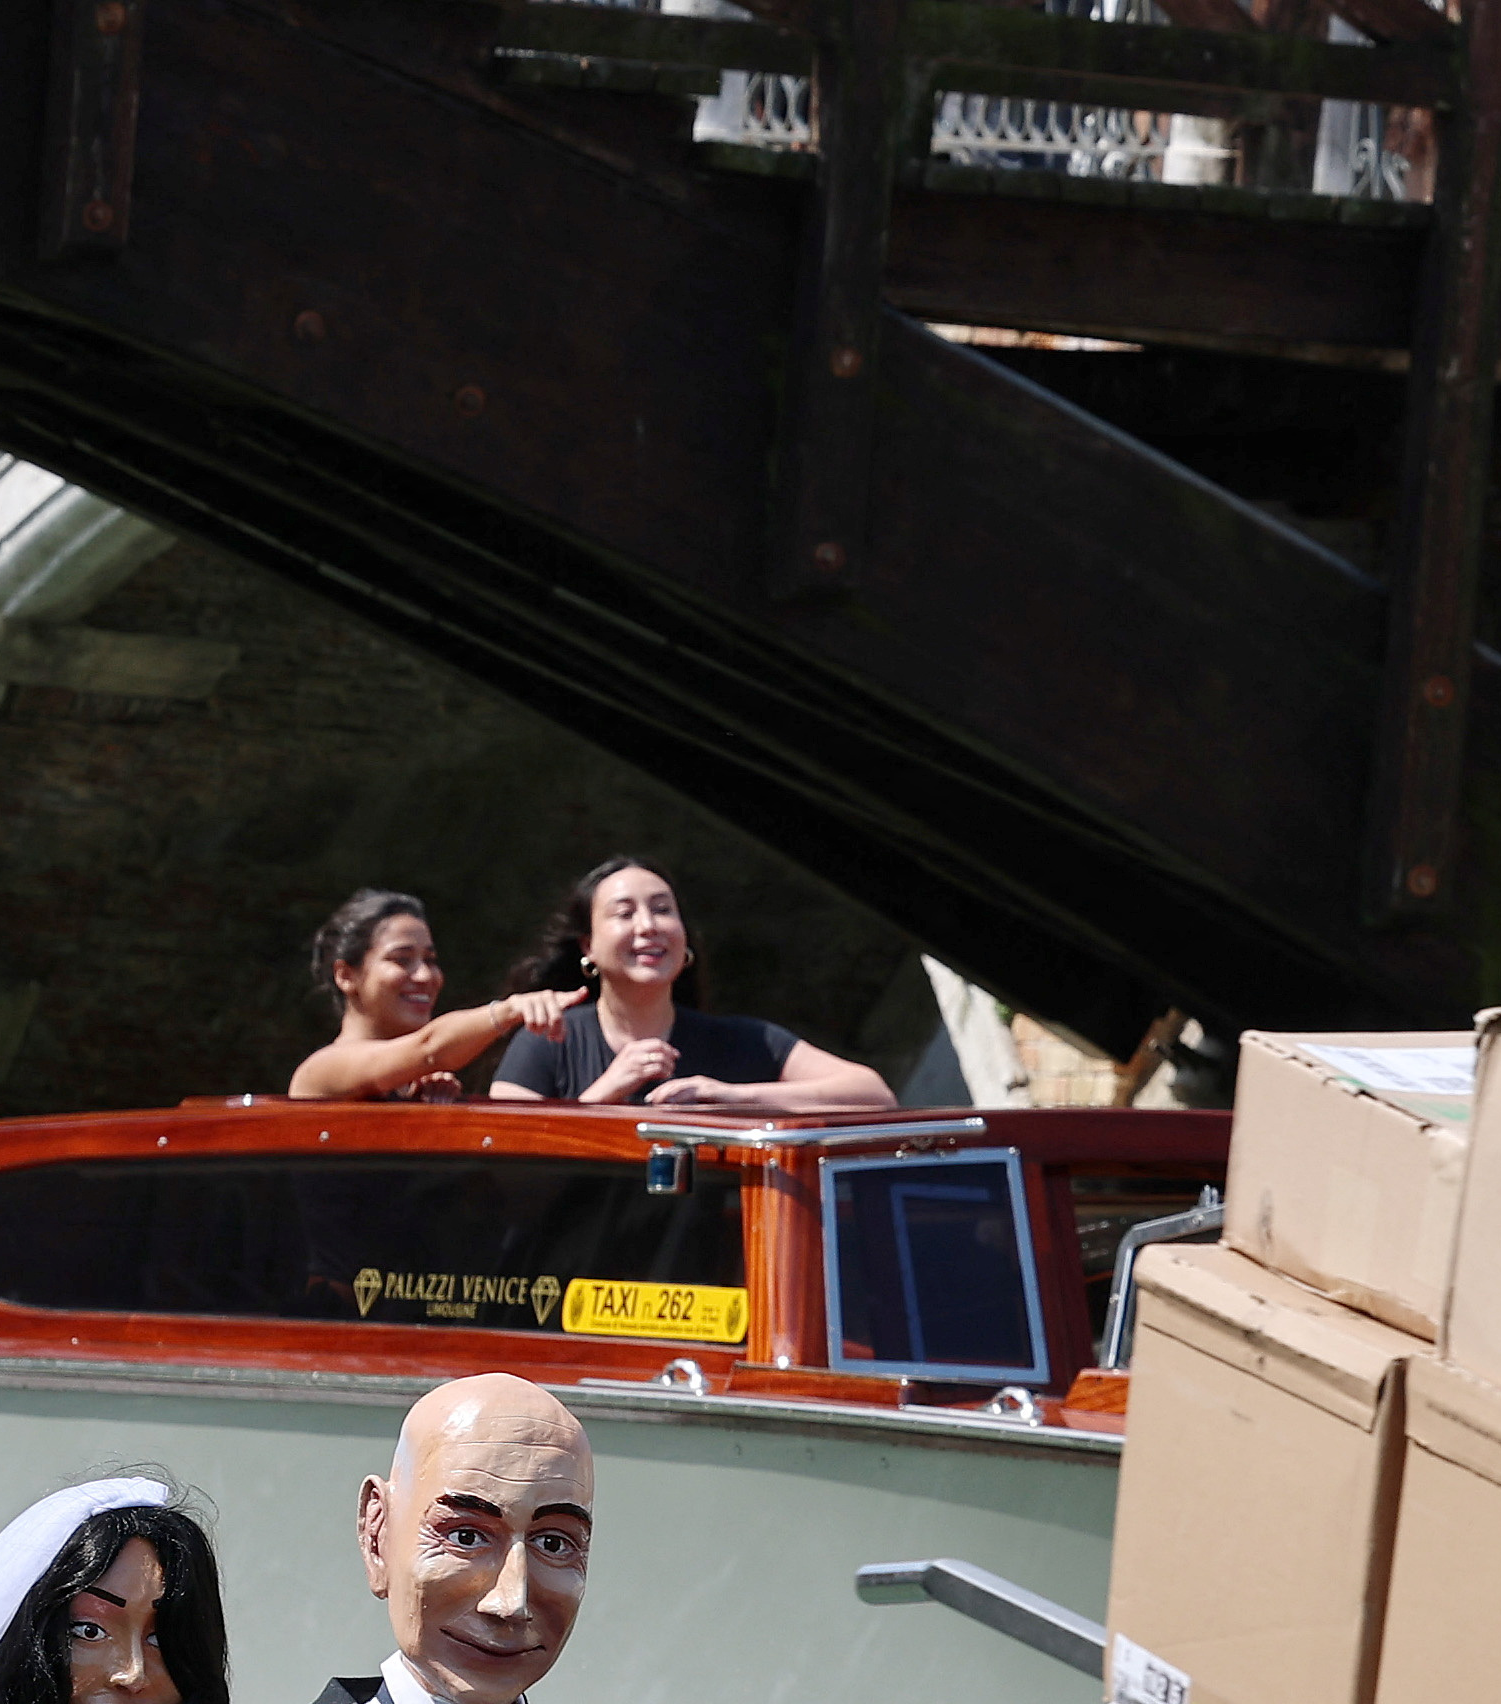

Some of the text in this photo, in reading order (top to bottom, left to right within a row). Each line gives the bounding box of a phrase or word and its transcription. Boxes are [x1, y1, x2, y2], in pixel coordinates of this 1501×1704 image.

[384, 1271, 530, 1305] PALAZZI VENICE
[592, 1285, 639, 1319] TAXI
[657, 1290, 695, 1321] 262
